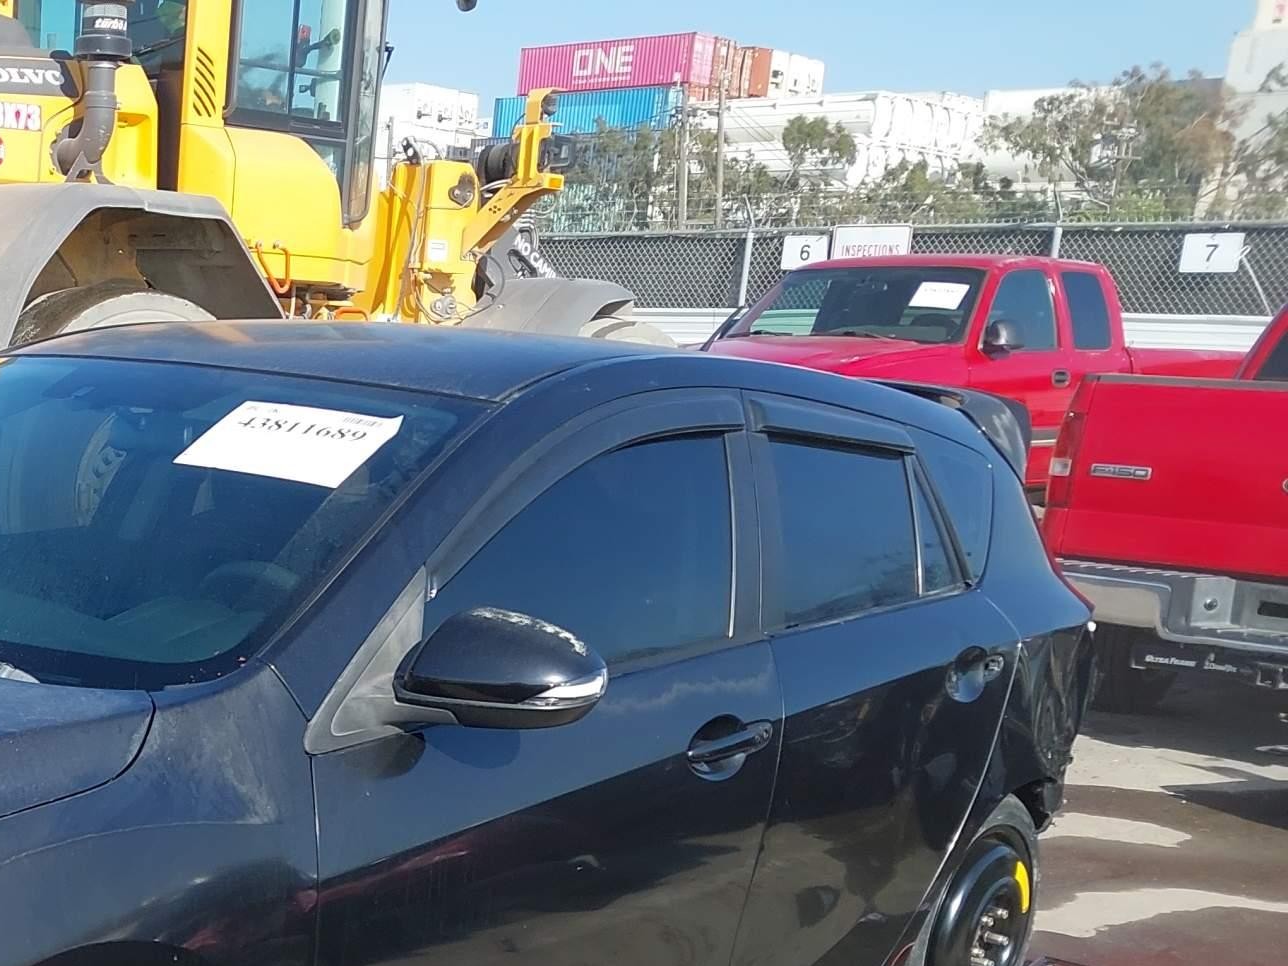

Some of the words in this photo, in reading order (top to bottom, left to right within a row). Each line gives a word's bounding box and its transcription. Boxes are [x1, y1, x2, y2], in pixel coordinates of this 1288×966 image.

[572, 44, 635, 76] ONE
[514, 233, 531, 256] NO
[799, 244, 811, 261] 6
[841, 243, 901, 257] INSPECTIONS
[1205, 244, 1219, 262] 7
[237, 416, 368, 441] 43811689
